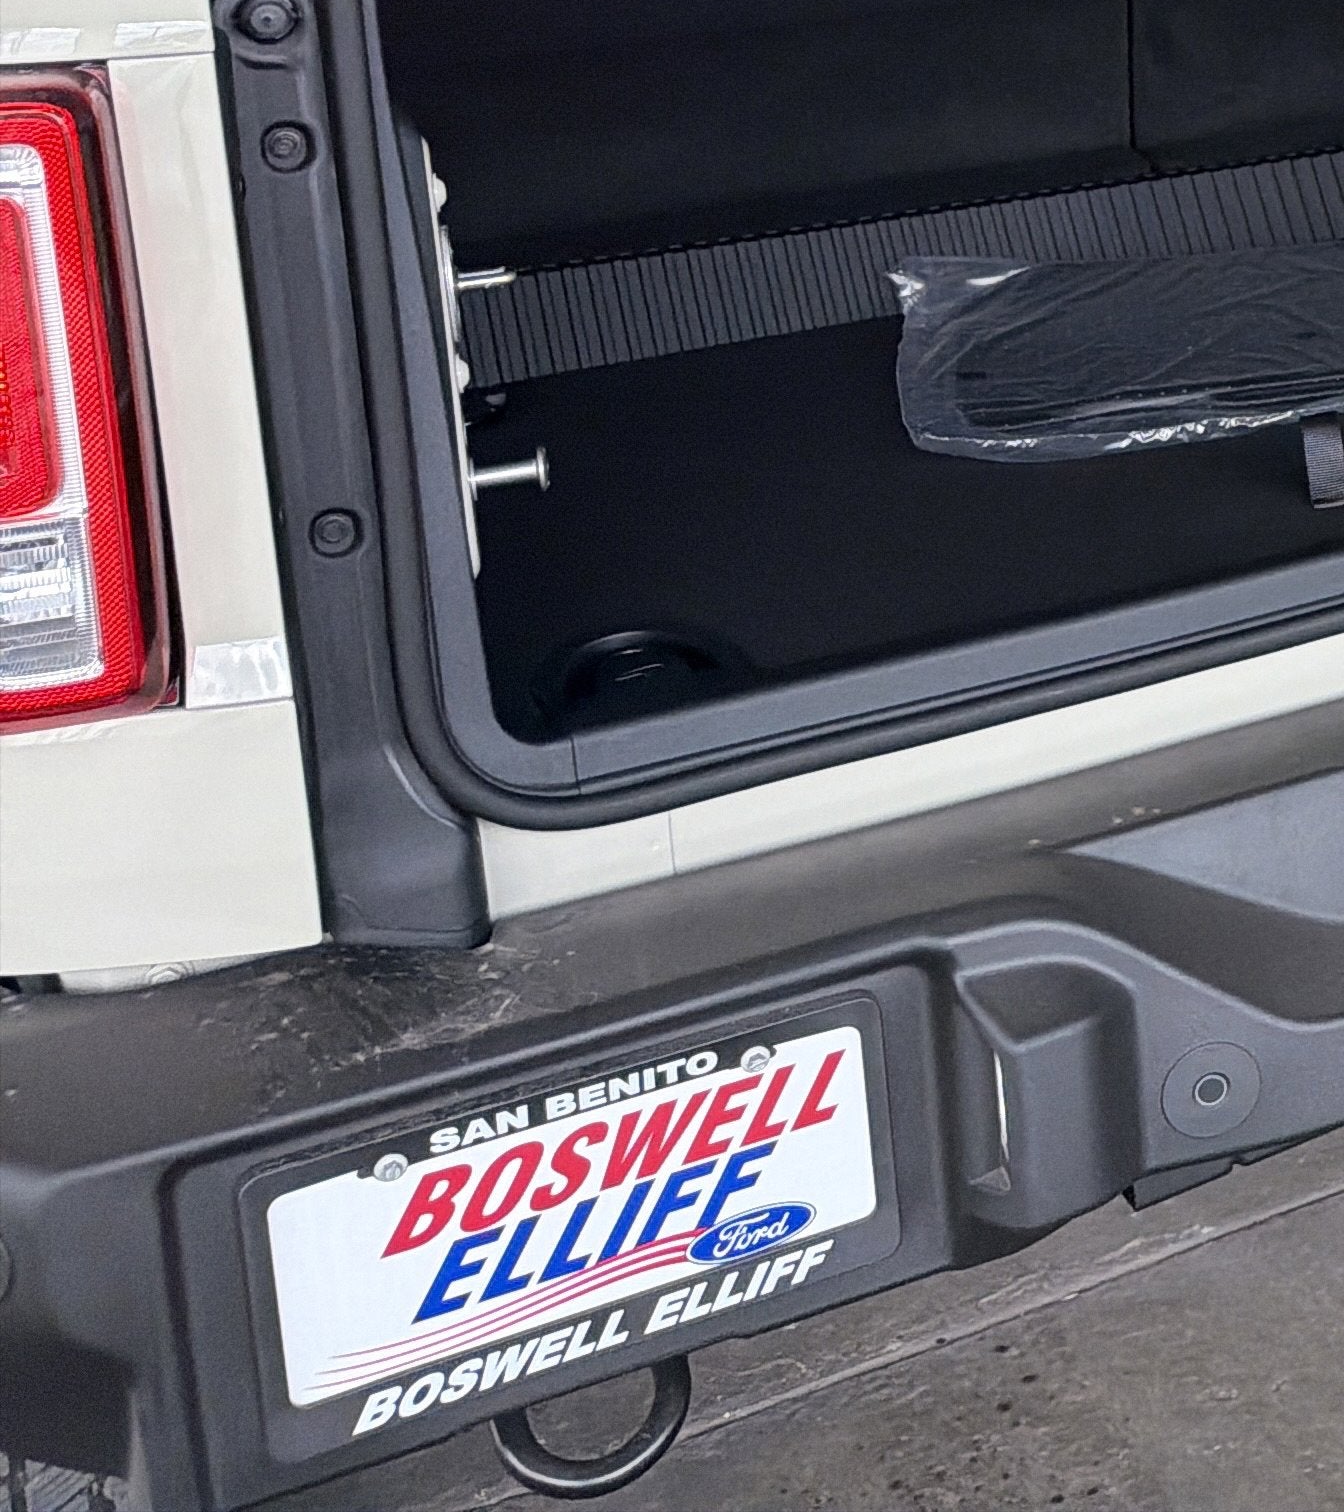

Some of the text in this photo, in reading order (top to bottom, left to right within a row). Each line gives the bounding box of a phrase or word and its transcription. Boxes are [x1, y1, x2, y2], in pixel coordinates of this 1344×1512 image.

[381, 1049, 846, 1258] BOSWELL
[429, 1050, 719, 1155] SAN BENITO
[412, 1143, 774, 1324] ELLIFF
[711, 1213, 790, 1258] Ford
[351, 1240, 836, 1438] BOSWELL ELLIFF
